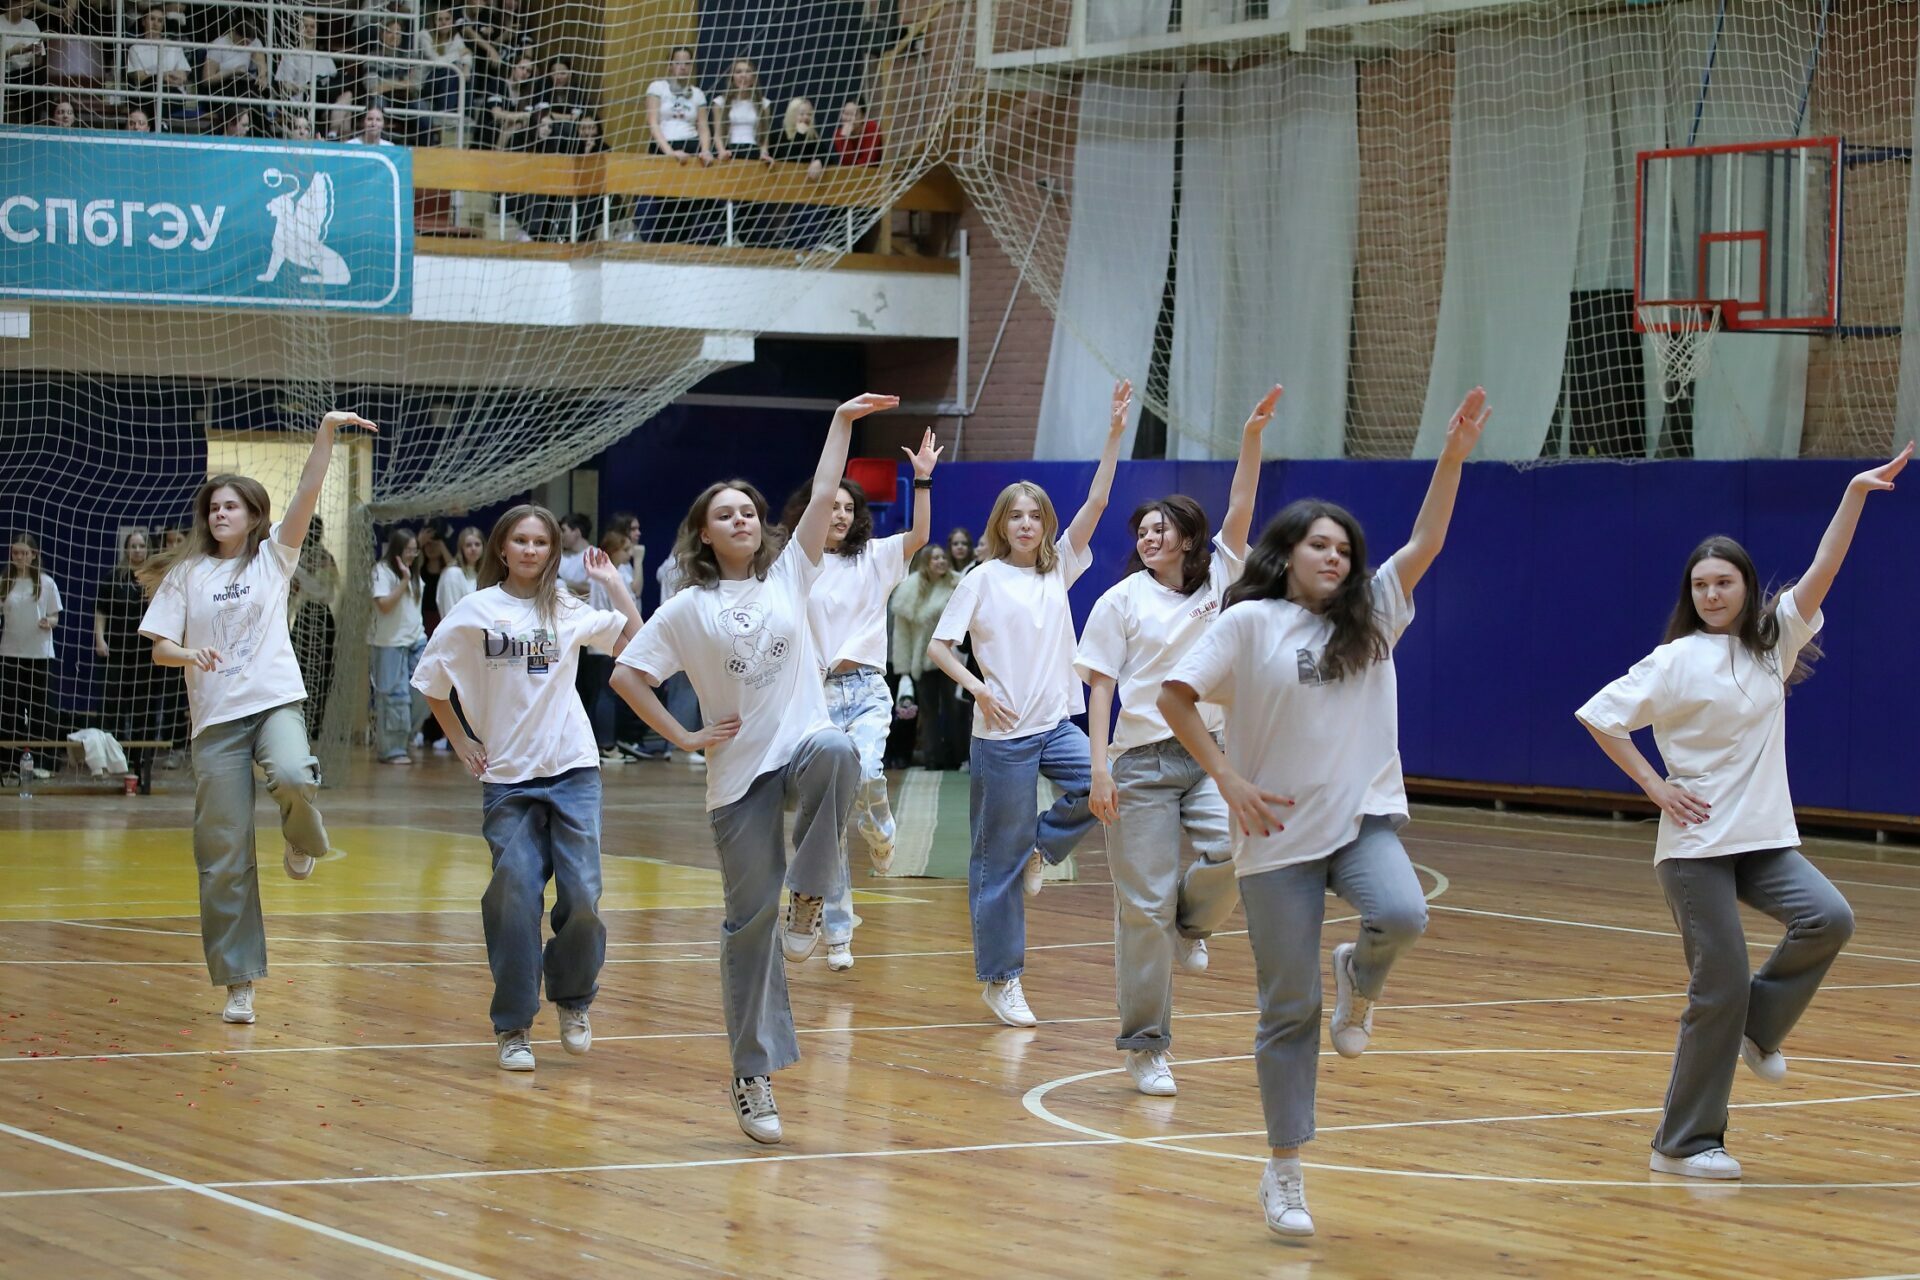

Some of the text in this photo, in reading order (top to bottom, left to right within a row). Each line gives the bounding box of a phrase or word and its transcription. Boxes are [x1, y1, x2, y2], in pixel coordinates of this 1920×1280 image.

[0, 195, 226, 251] СПбГЭУ
[213, 586, 250, 602] MOMENT
[224, 583, 240, 593] THE
